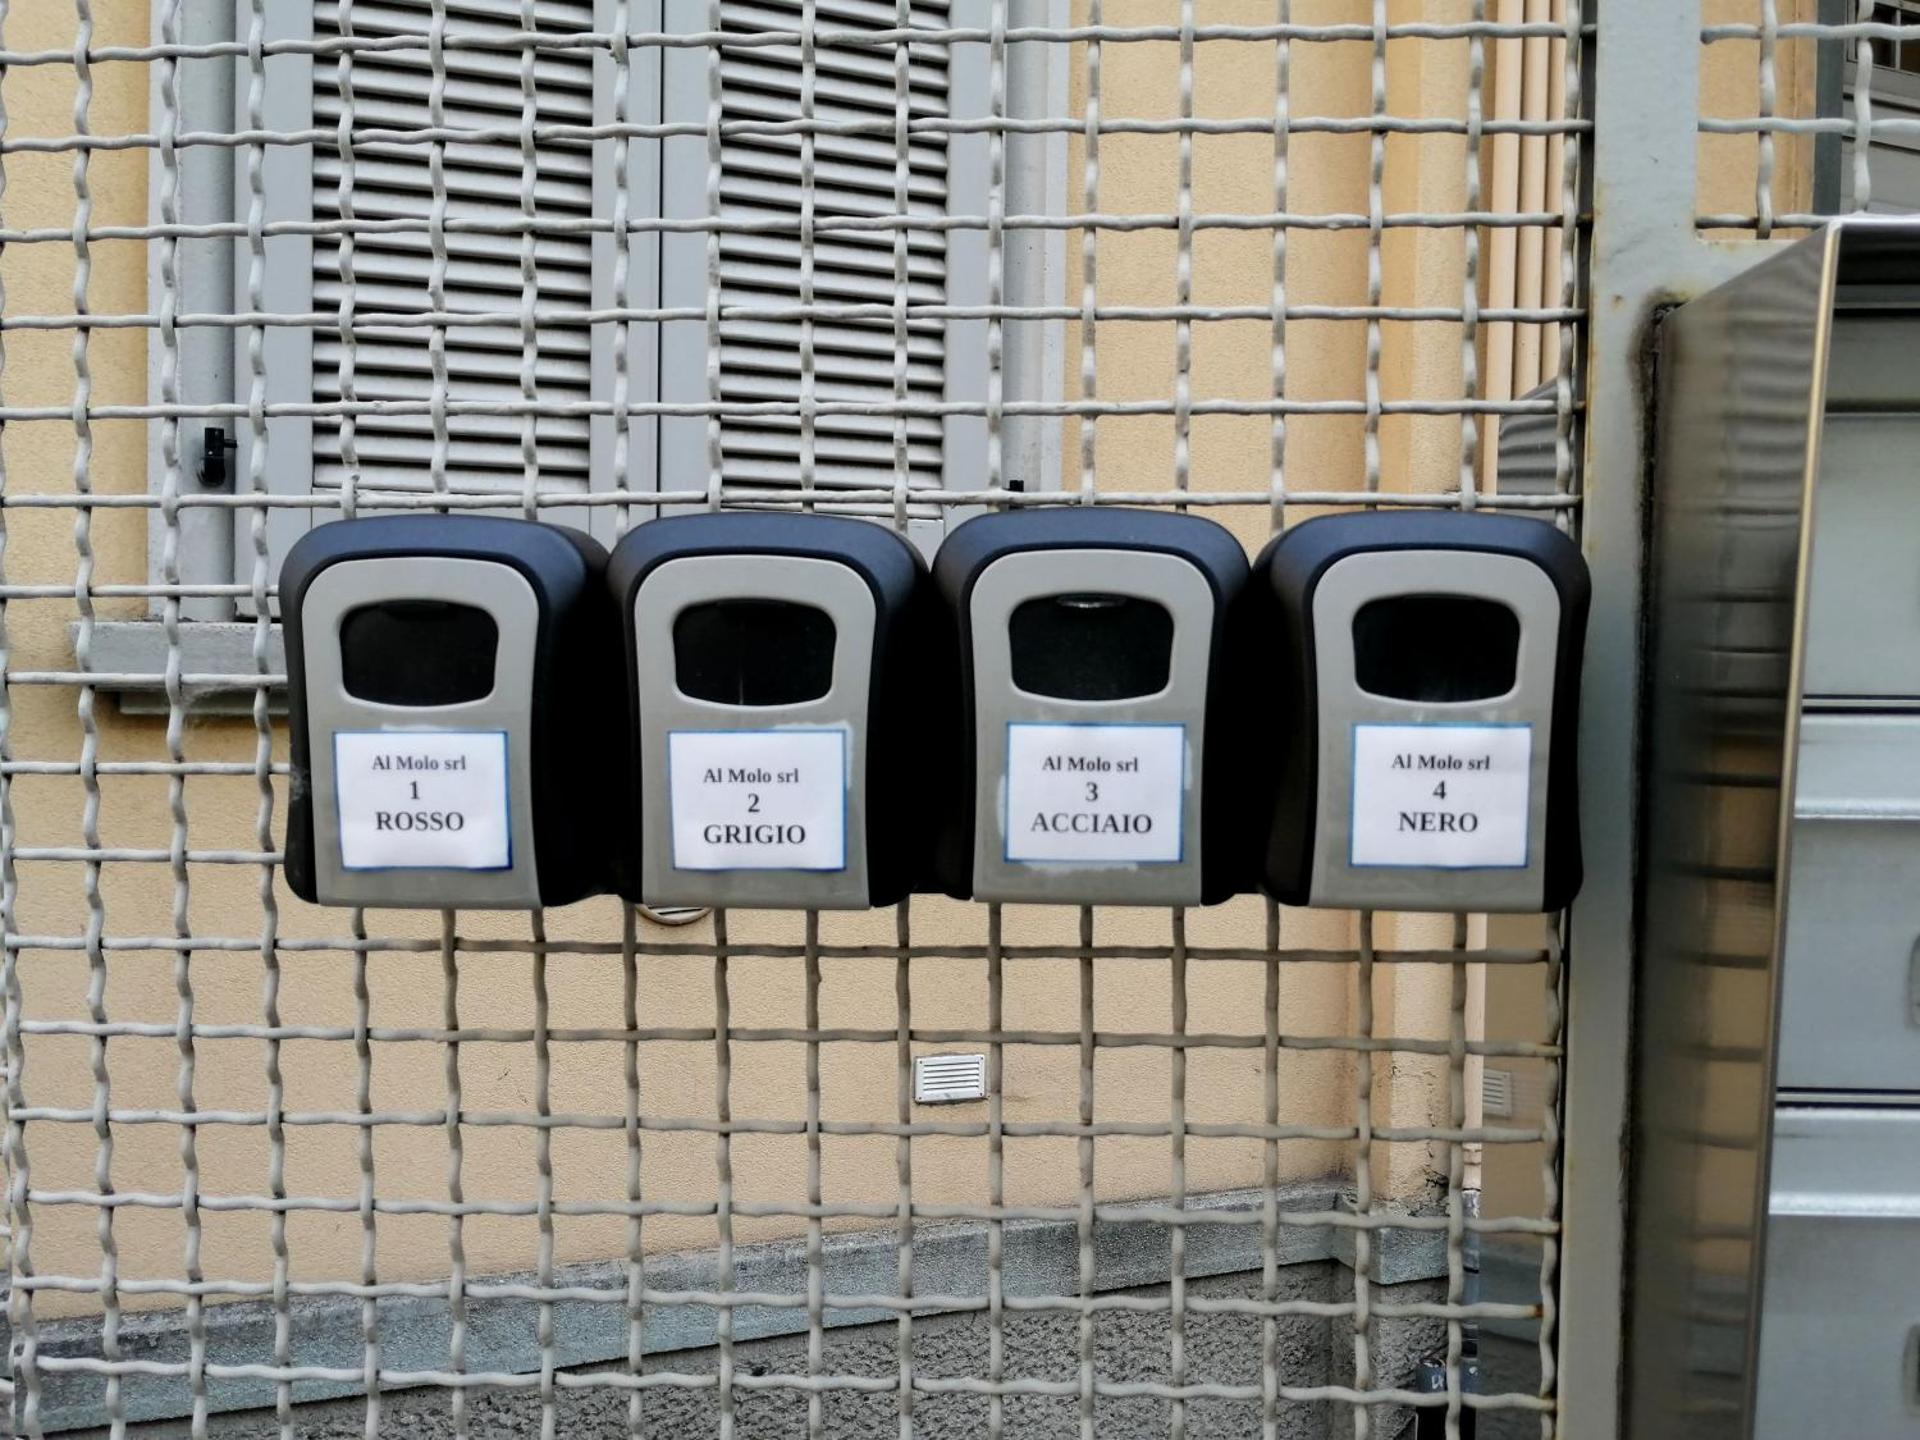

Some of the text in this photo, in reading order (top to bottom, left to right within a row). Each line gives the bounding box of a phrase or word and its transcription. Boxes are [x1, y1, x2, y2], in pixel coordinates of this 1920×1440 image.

[372, 755, 466, 770] Al Molo srl
[1042, 756, 1138, 772] Al Molo srl
[1391, 754, 1490, 770] Al Molo srl
[703, 768, 799, 783] Al Molo srl
[410, 780, 421, 800] 1
[1085, 782, 1099, 802] 3
[1432, 780, 1447, 800] 4
[747, 793, 760, 813] 2
[376, 811, 465, 831] ROSSO
[1030, 812, 1153, 834] ACCIAIO
[1398, 811, 1479, 832] NERO
[703, 824, 806, 844] GRIGIO
